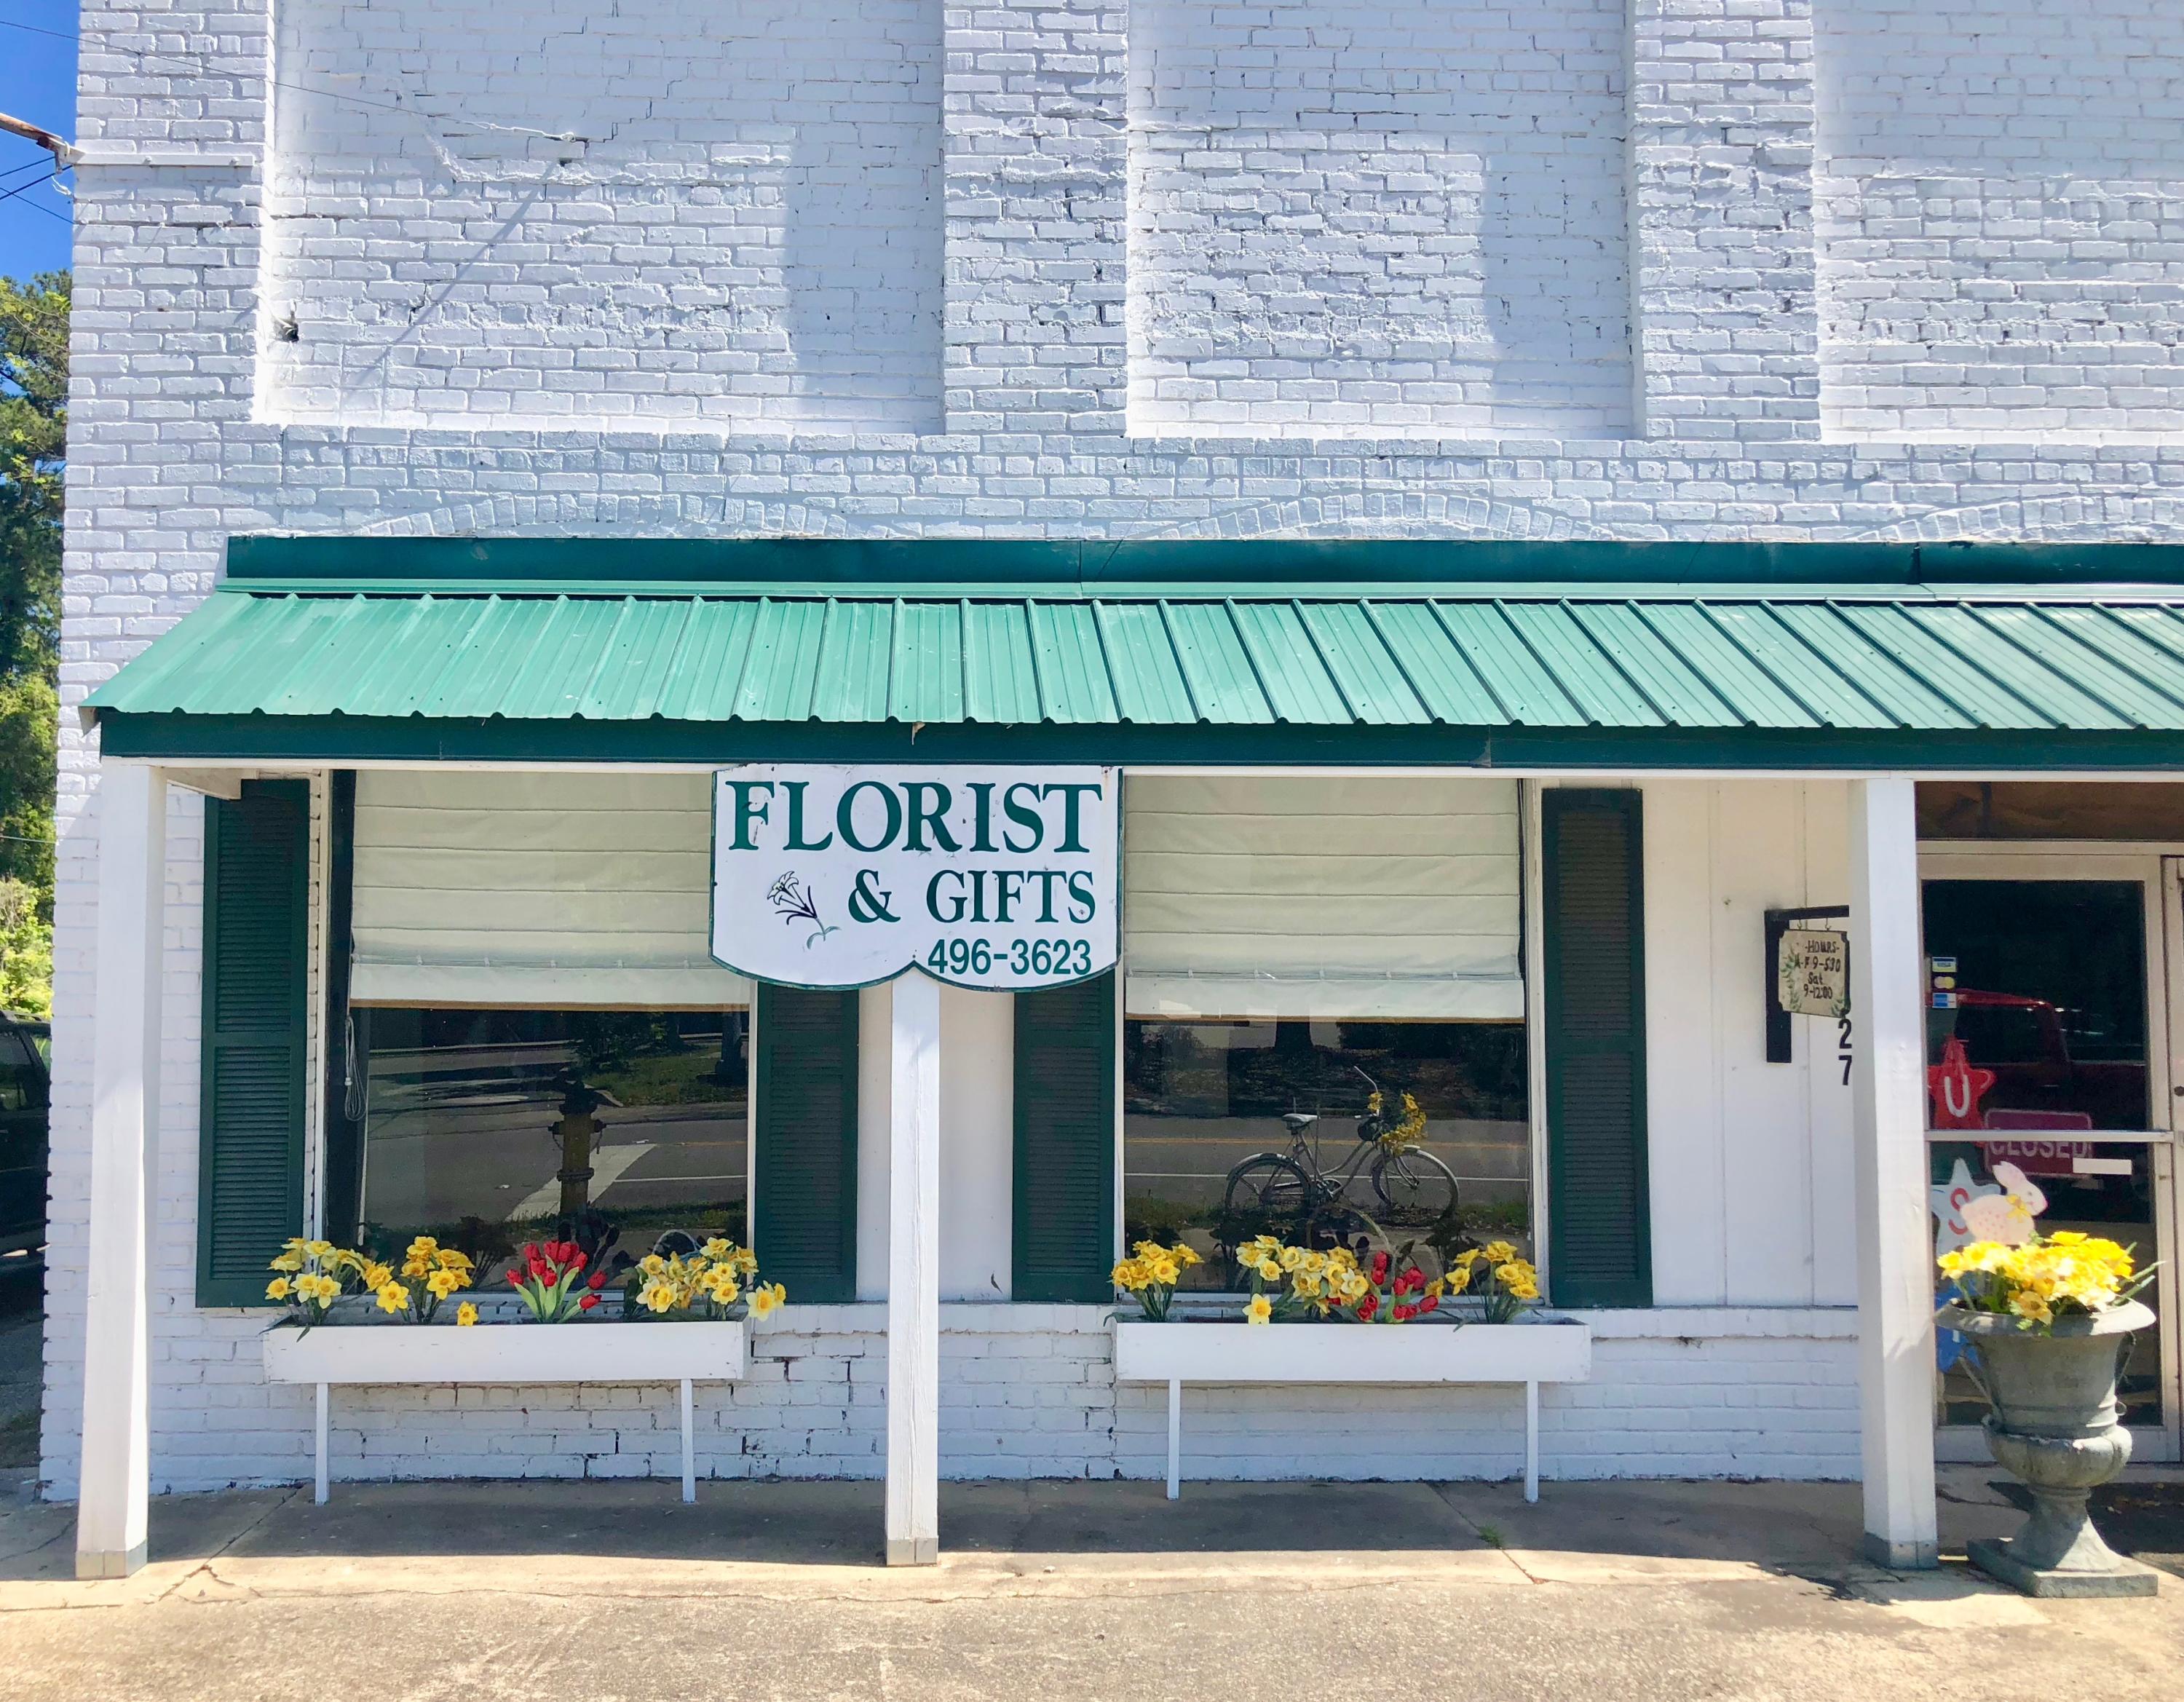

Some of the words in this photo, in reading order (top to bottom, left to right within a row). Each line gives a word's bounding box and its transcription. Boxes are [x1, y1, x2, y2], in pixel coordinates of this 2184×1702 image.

[725, 781, 1102, 853] FLORIST
[848, 869, 901, 923] &
[927, 869, 1096, 923] GIFTS
[927, 938, 1092, 975] 496-3623
[1808, 972, 1823, 984] Sat
[1990, 1127, 2087, 1159] CLOSED
